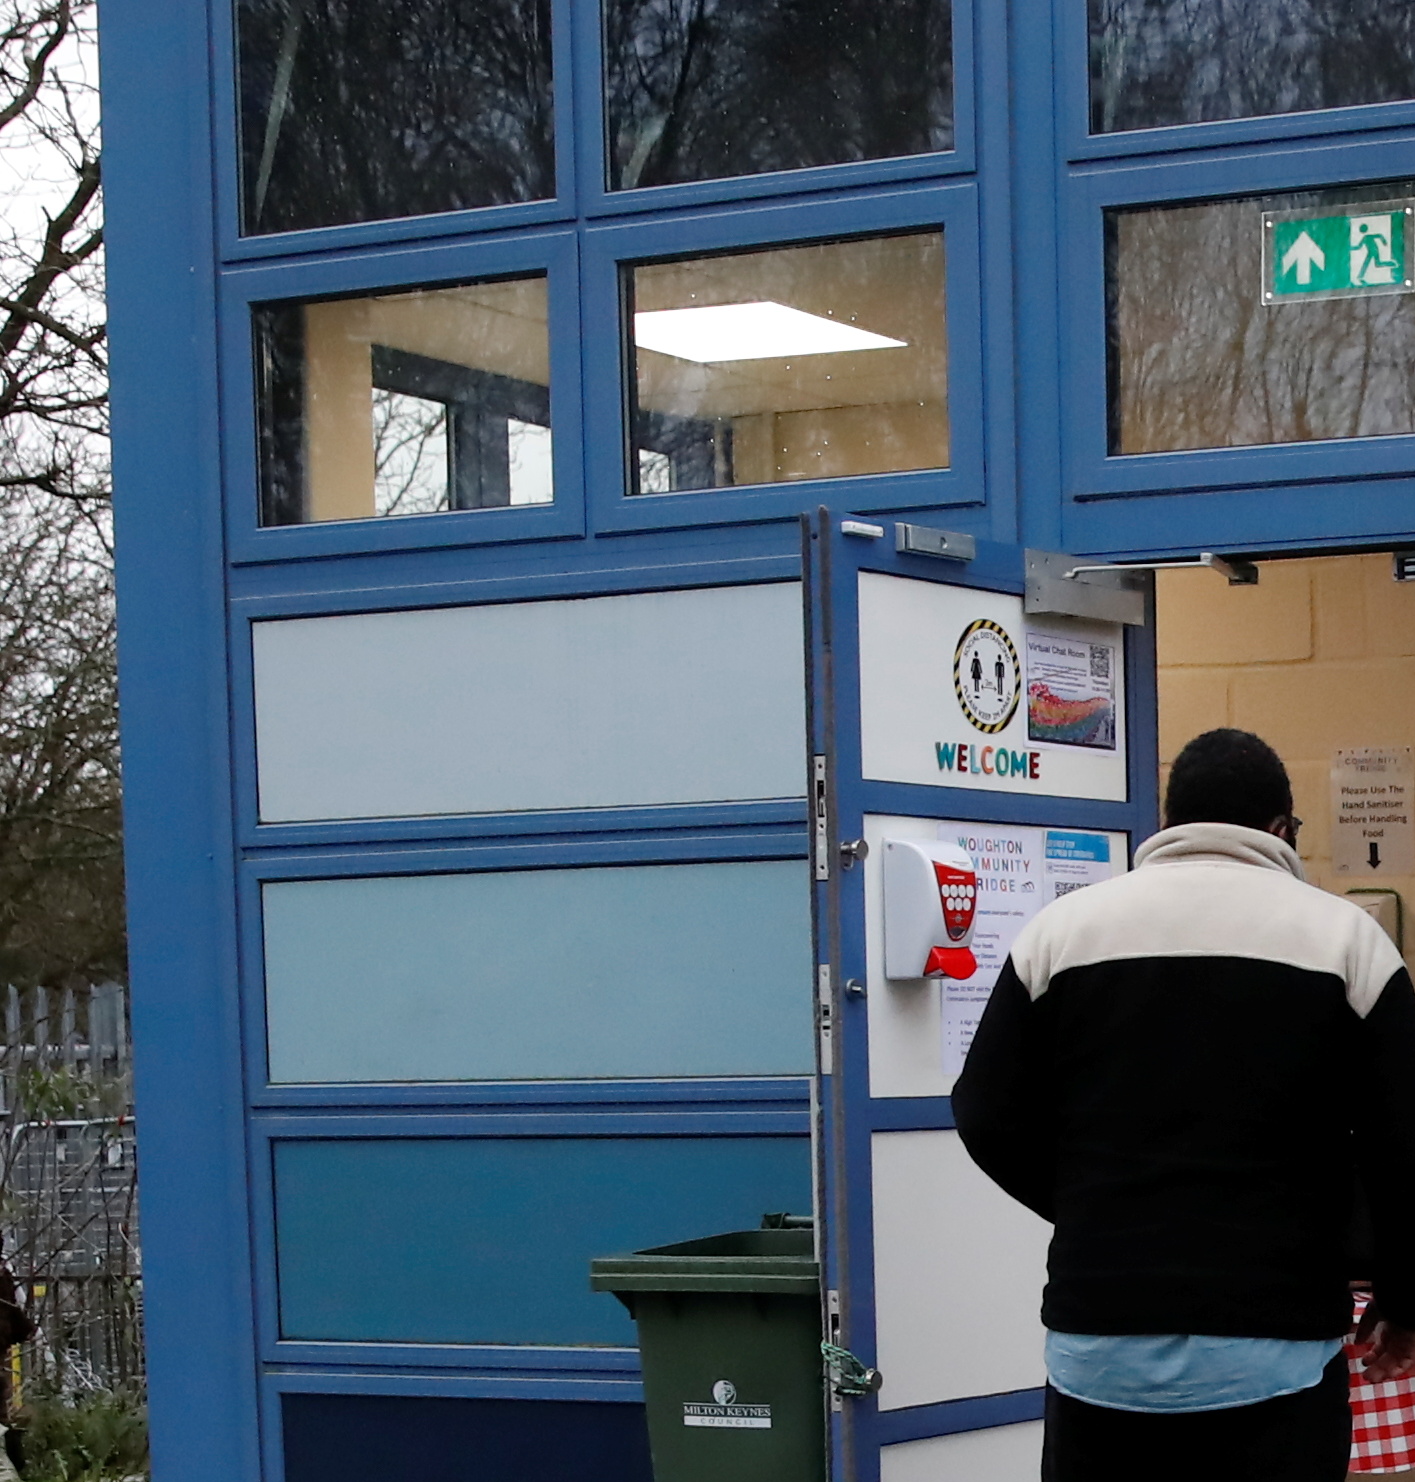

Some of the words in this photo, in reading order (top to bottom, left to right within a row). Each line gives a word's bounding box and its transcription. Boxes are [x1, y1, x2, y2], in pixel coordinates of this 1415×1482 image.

[1028, 641, 1051, 654] Virtual
[1051, 645, 1067, 657] Chat
[1068, 648, 1086, 659] Room
[935, 741, 1041, 779] WELCOME
[1341, 786, 1368, 795] Please
[1370, 786, 1386, 794] Use
[1388, 785, 1405, 794] The
[1342, 801, 1365, 809] Hand
[1366, 800, 1403, 809] Sanitiser
[1339, 815, 1367, 824] Before
[1369, 814, 1407, 824] Handling
[1362, 829, 1384, 838] Food
[957, 836, 1023, 854] WOUGHTON
[973, 856, 1032, 873] MMUNITY
[976, 879, 1016, 892] RIDGE
[683, 1405, 725, 1416] MILTON
[727, 1407, 771, 1417] KEYNES
[700, 1417, 754, 1426] COUNCIL
